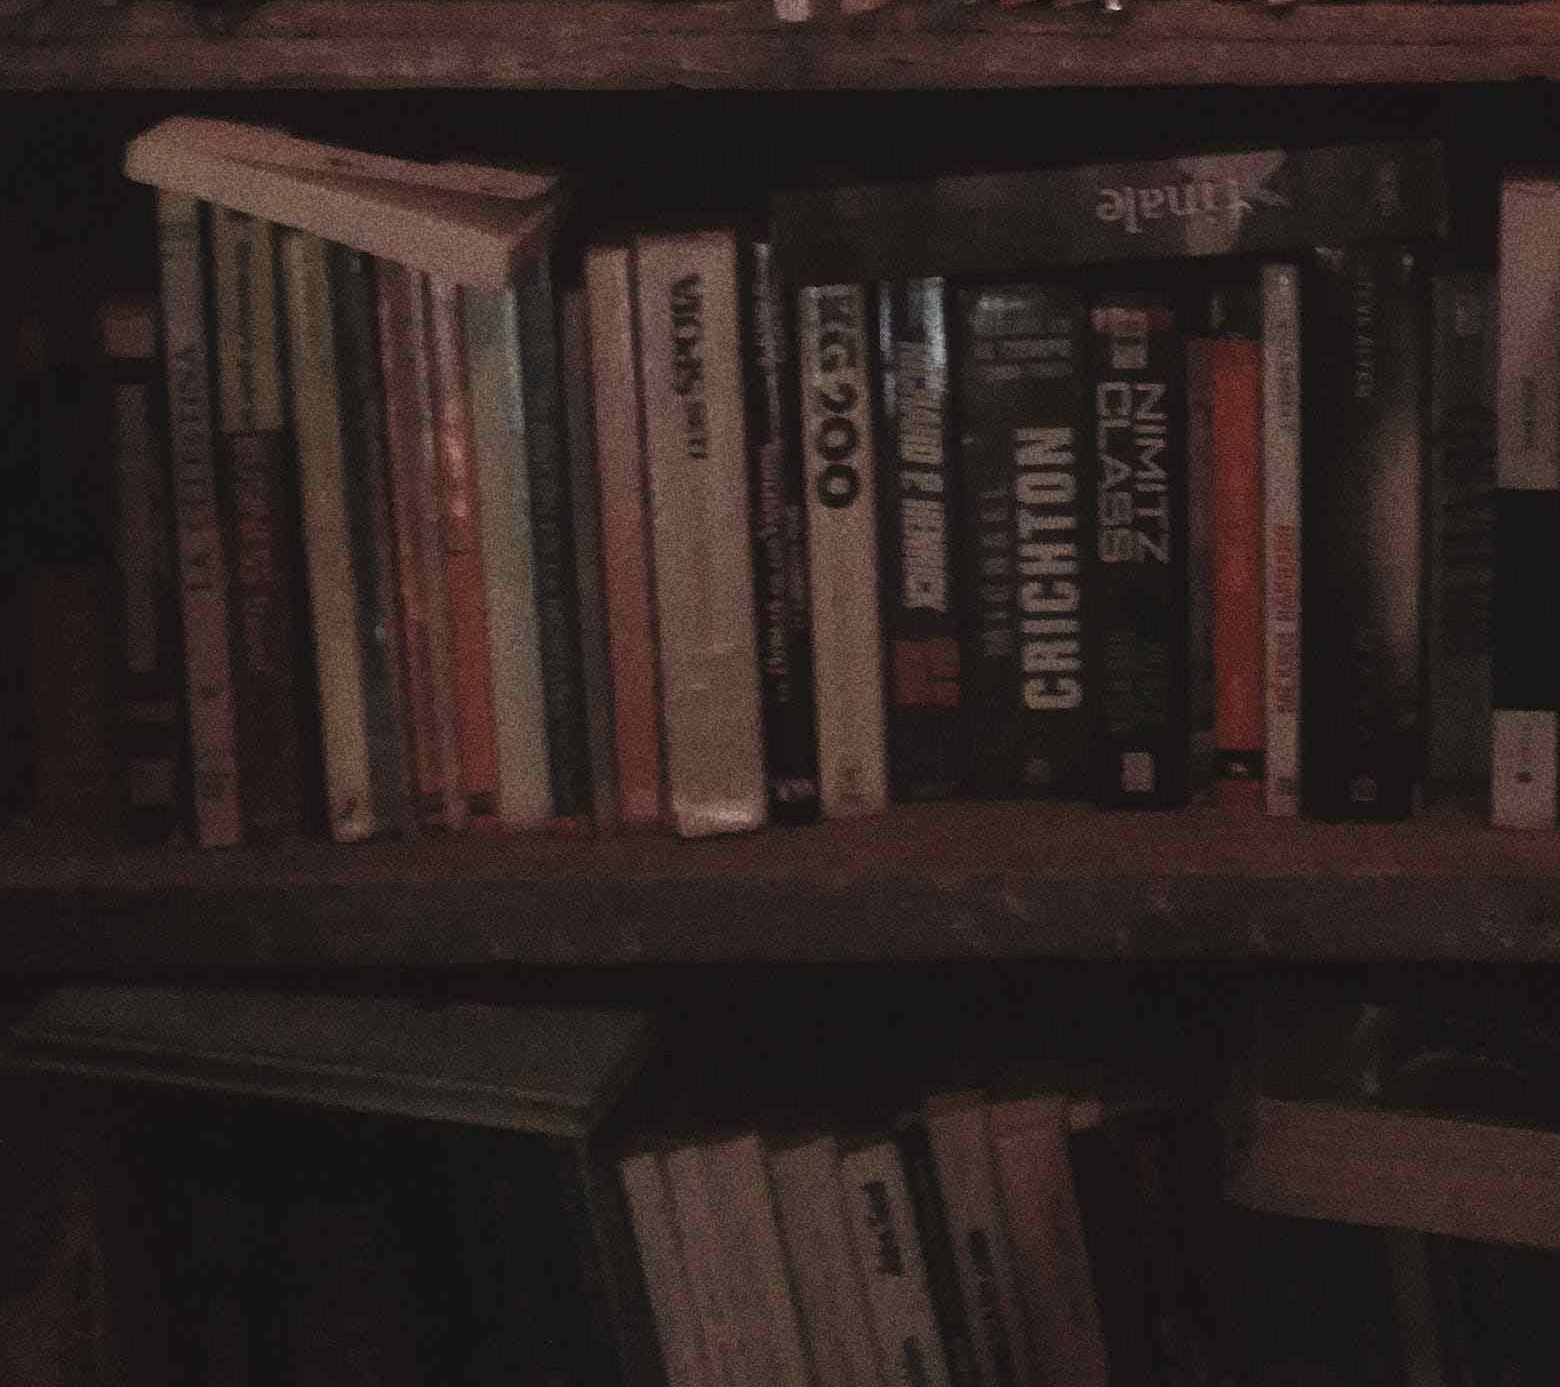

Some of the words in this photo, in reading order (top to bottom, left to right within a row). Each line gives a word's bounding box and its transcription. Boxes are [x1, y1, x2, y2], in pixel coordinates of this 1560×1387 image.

[818, 374, 862, 511] 200
[1096, 381, 1133, 564] CLASS
[1135, 381, 1170, 564] NIMITZ
[1014, 426, 1082, 710] CRICHTON
